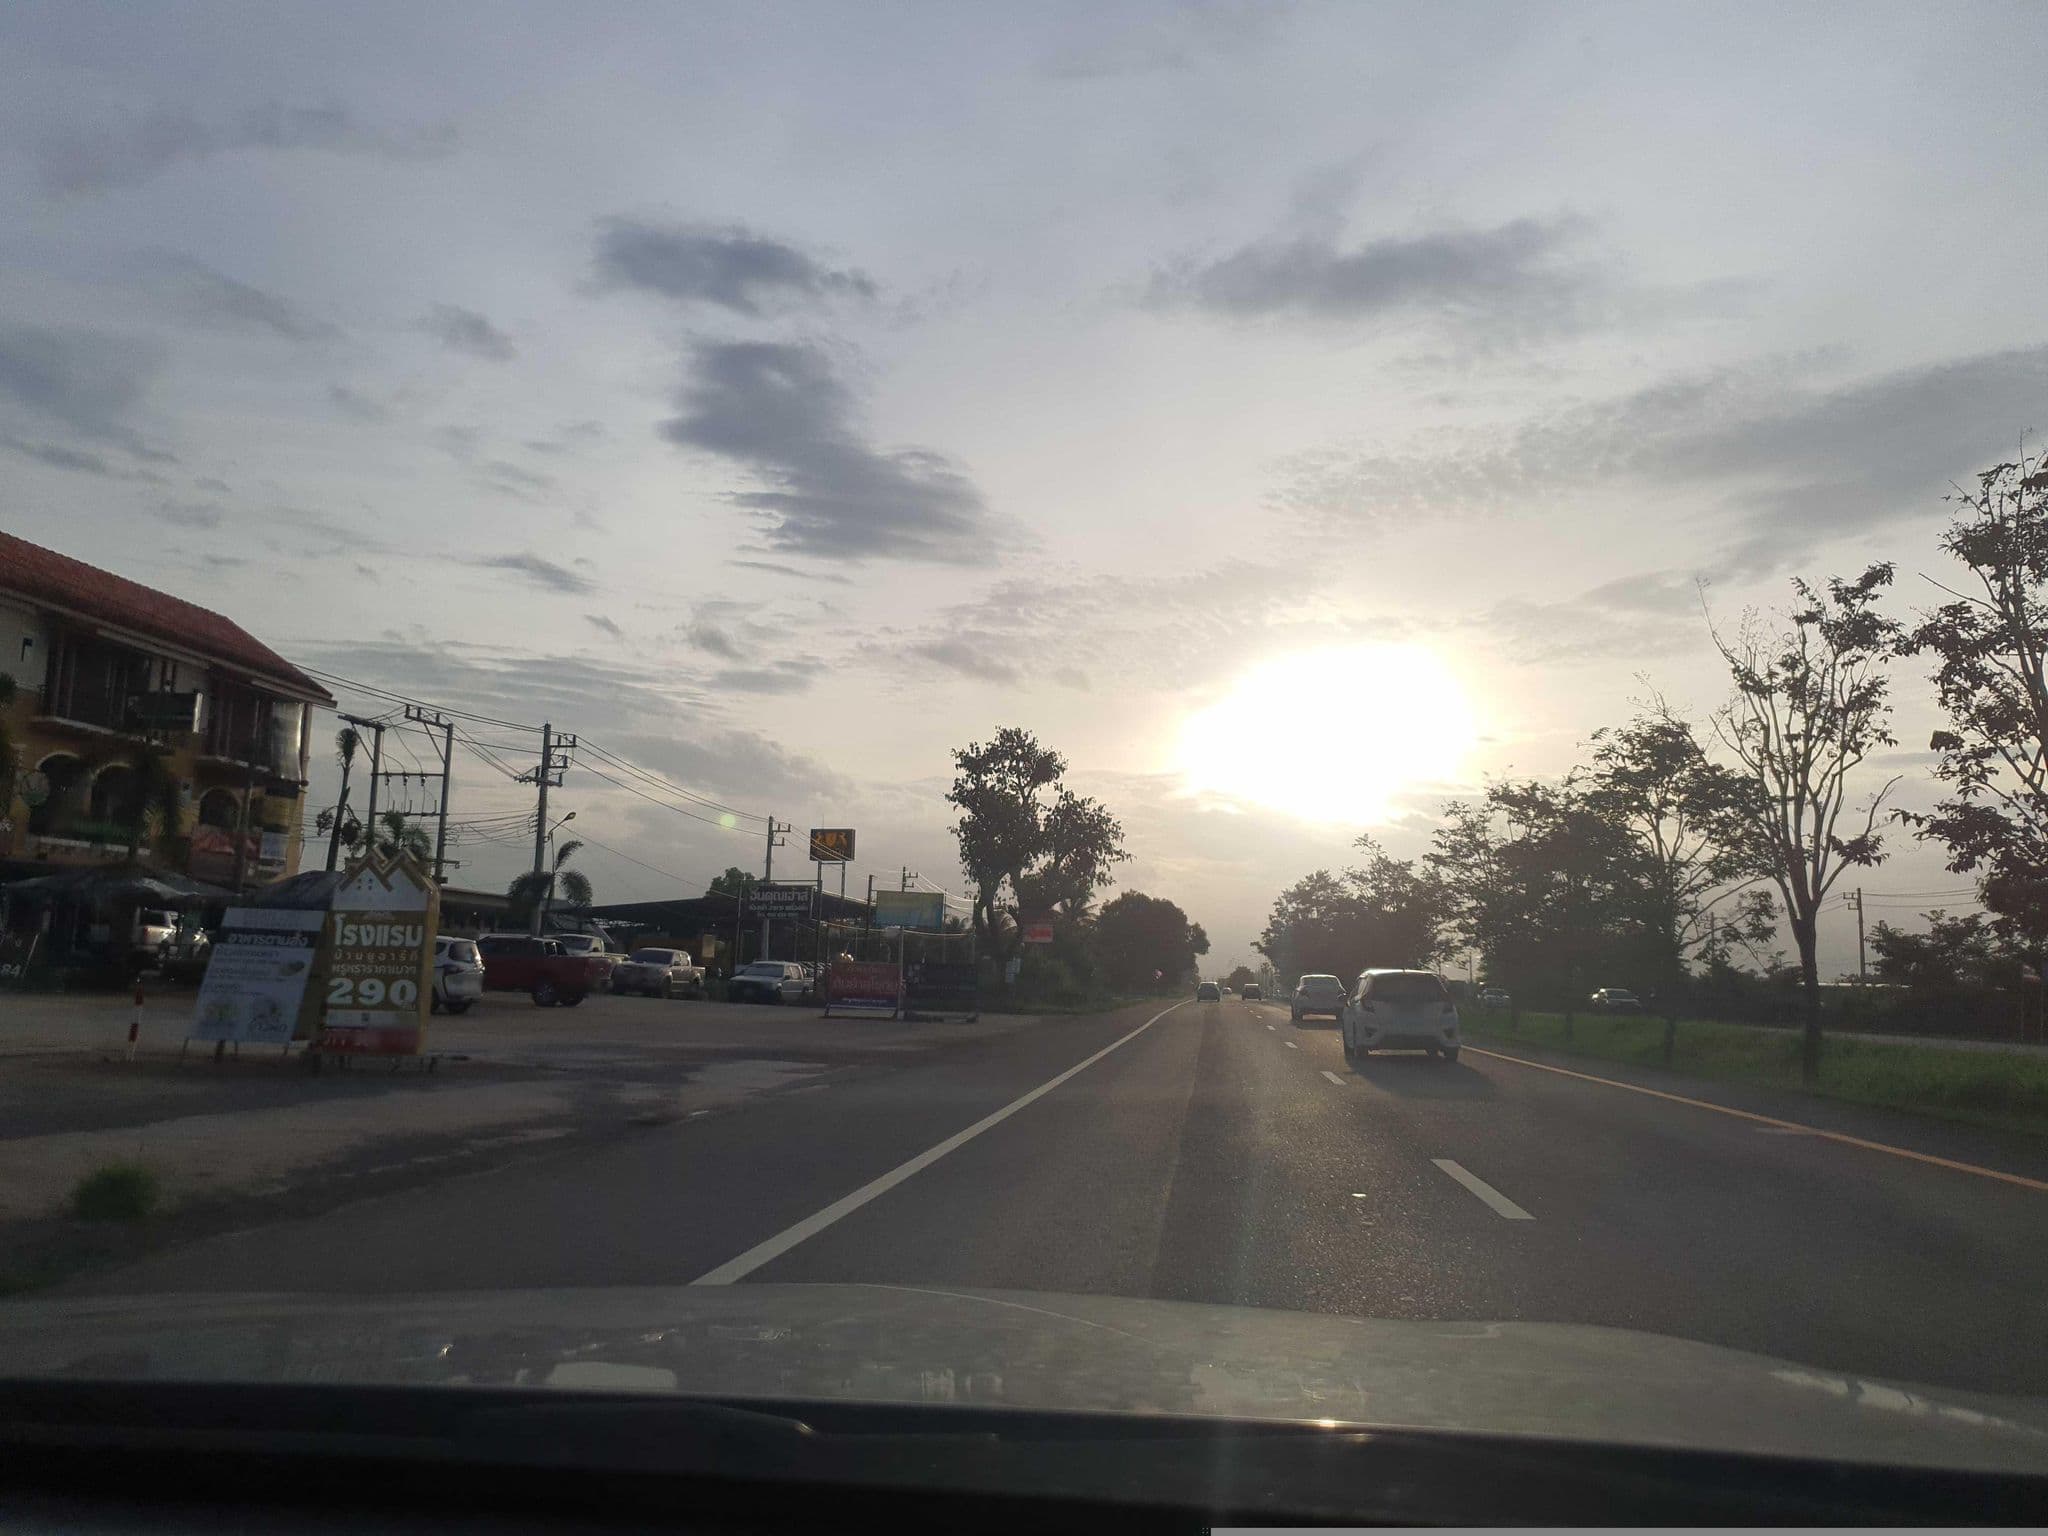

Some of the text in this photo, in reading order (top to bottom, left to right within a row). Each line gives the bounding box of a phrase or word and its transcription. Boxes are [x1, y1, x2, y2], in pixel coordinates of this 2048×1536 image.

[334, 913, 425, 947] โรงแรม
[326, 977, 418, 1007] 290
